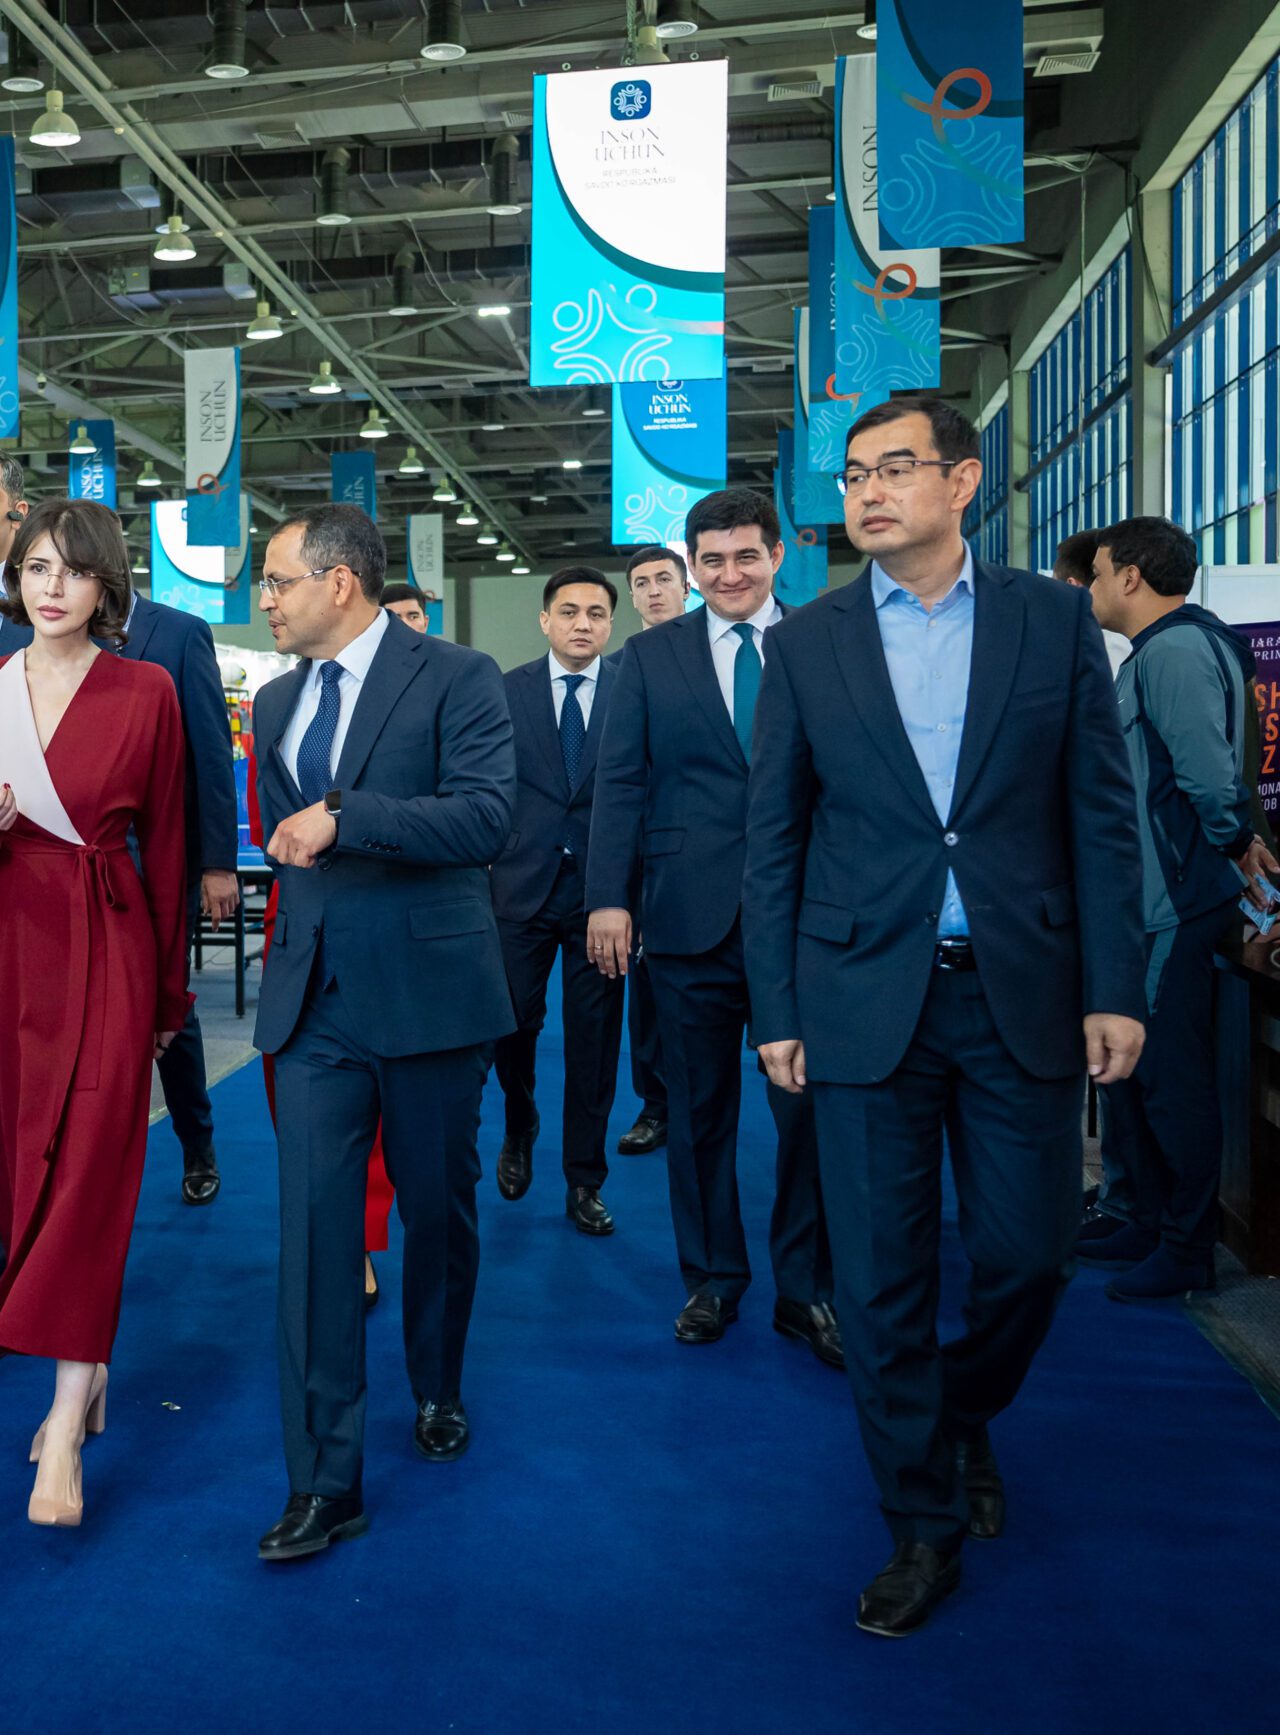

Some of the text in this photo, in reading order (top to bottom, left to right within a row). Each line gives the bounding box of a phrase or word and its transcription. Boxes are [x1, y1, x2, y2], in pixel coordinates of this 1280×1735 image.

[600, 127, 660, 145] INSON
[594, 143, 665, 162] UCHUN
[651, 393, 688, 405] INSON
[199, 388, 213, 442] INSON
[213, 379, 226, 442] UCHUN
[648, 402, 692, 415] UCHUN
